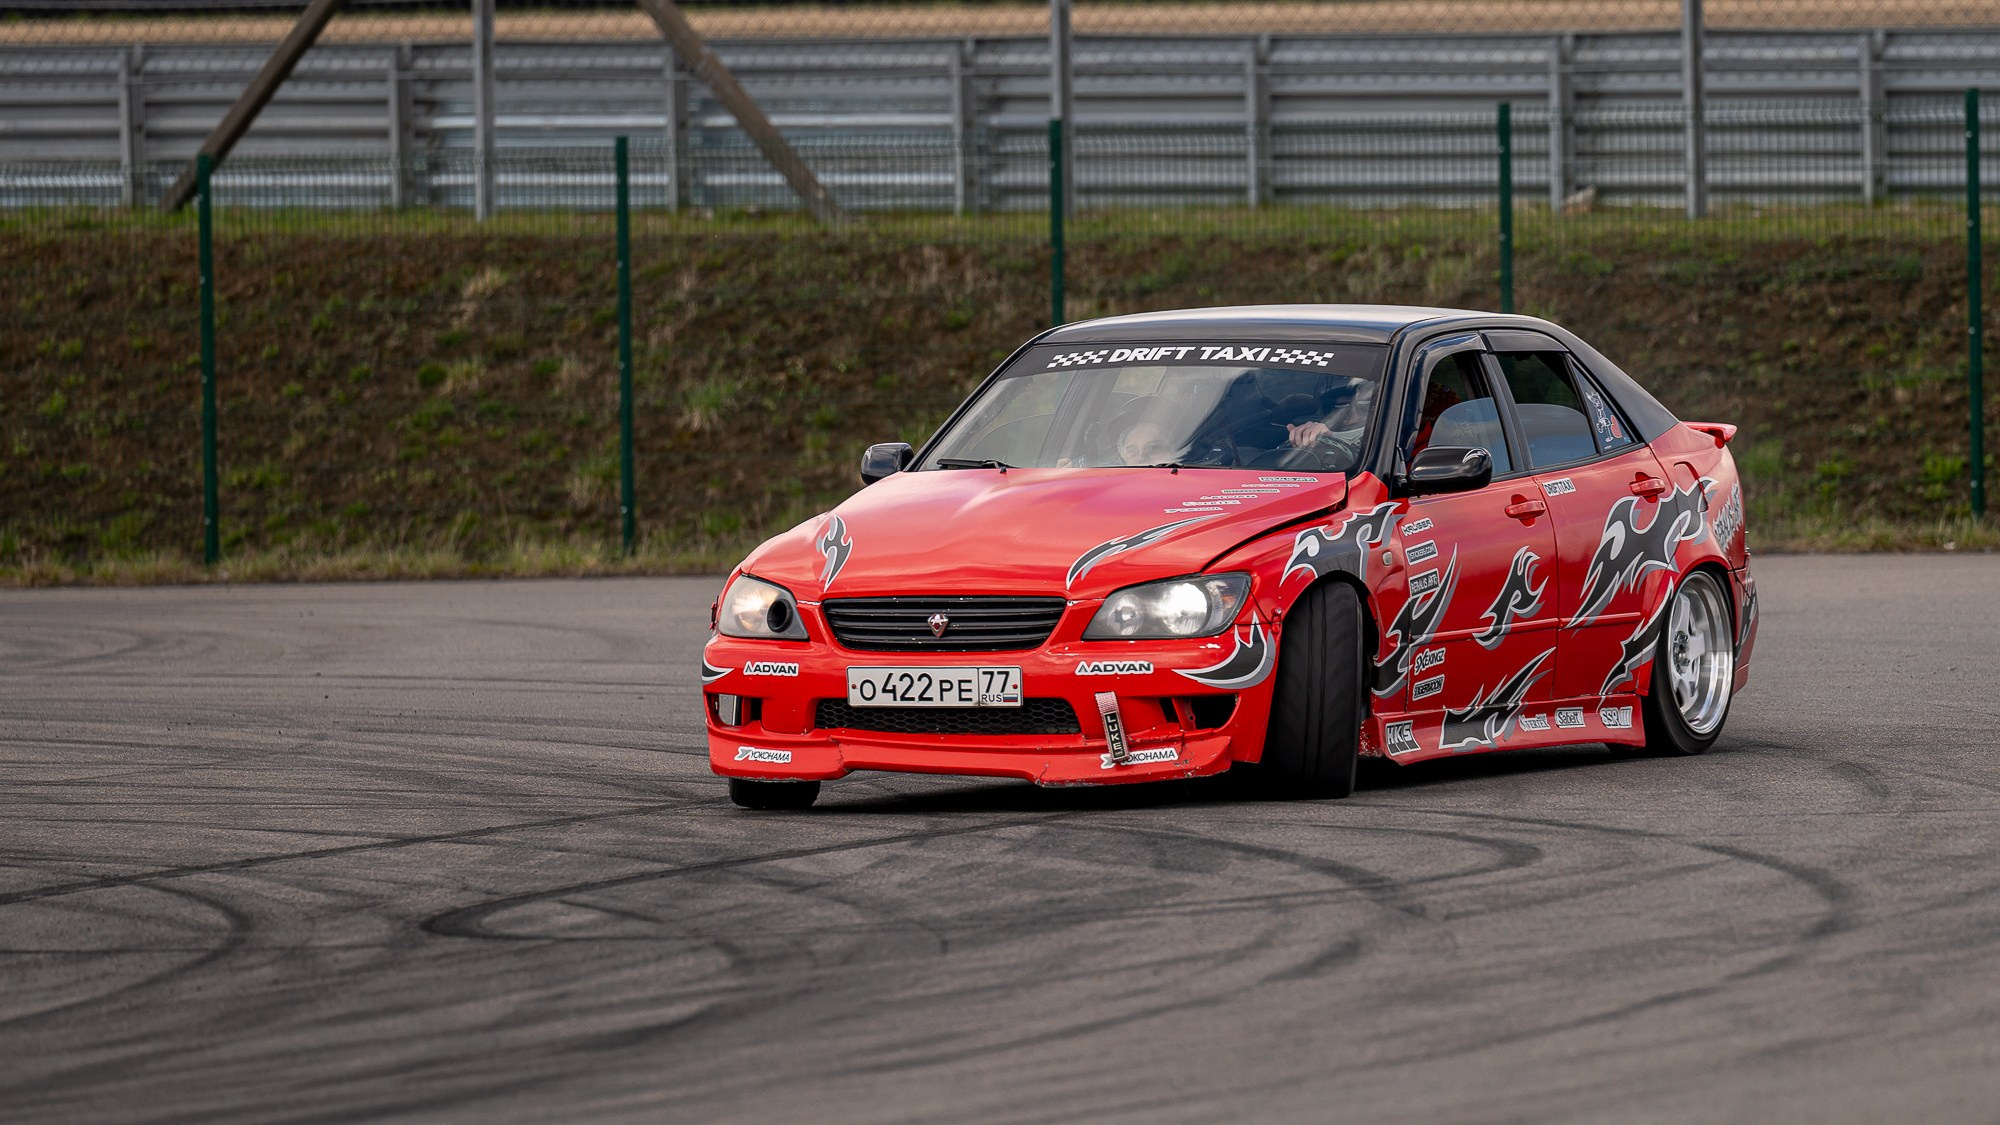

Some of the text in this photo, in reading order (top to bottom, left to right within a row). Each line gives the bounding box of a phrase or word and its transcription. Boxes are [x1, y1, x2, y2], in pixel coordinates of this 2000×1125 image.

[1107, 346, 1272, 363] DRIFT TAXI
[1402, 519, 1433, 534] KRUGER
[753, 664, 797, 674] ADVAN
[1090, 663, 1151, 673] ADVAN
[982, 670, 1010, 693] 77
[981, 694, 1002, 702] RUS
[1106, 715, 1122, 751] LUKE
[1387, 724, 1412, 745] HKS
[750, 750, 790, 762] YOKOHAMA
[1124, 750, 1176, 763] OKOHAMA
